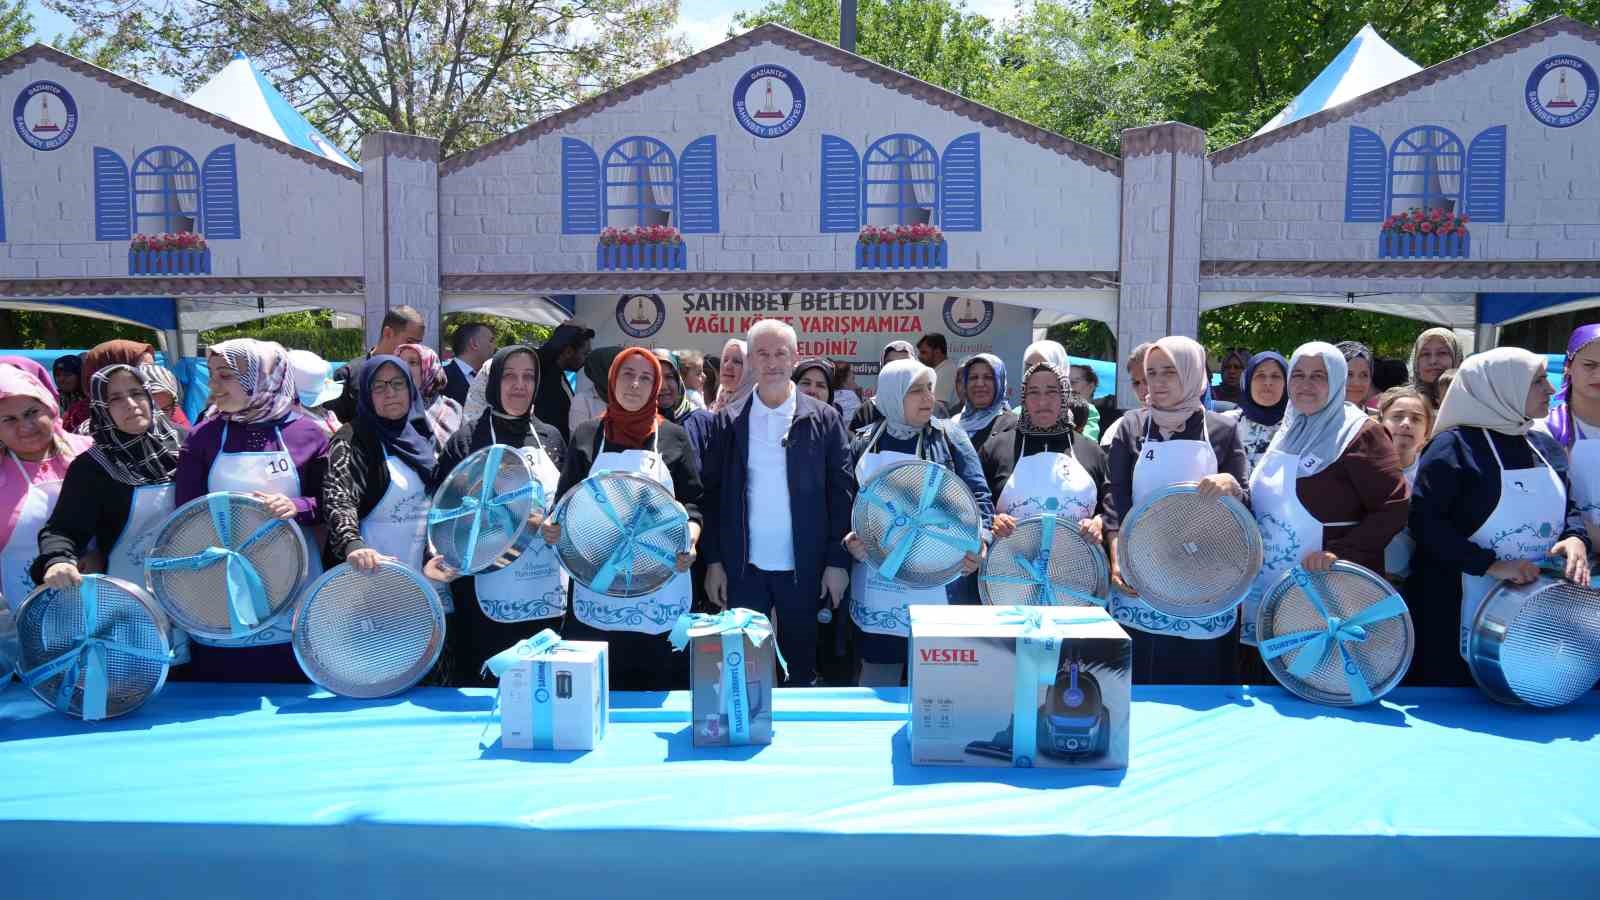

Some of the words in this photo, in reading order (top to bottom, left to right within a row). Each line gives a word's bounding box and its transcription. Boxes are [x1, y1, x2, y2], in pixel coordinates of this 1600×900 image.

[685, 313, 735, 334] YAĞLI
[800, 315, 923, 335] YARIŞMAMIZA
[797, 339, 857, 356] ELDİNİZ
[1145, 449, 1154, 461] 4
[1303, 457, 1316, 468] 3
[268, 458, 289, 473] 10
[649, 457, 656, 469] 7
[920, 648, 978, 663] VESTEL
